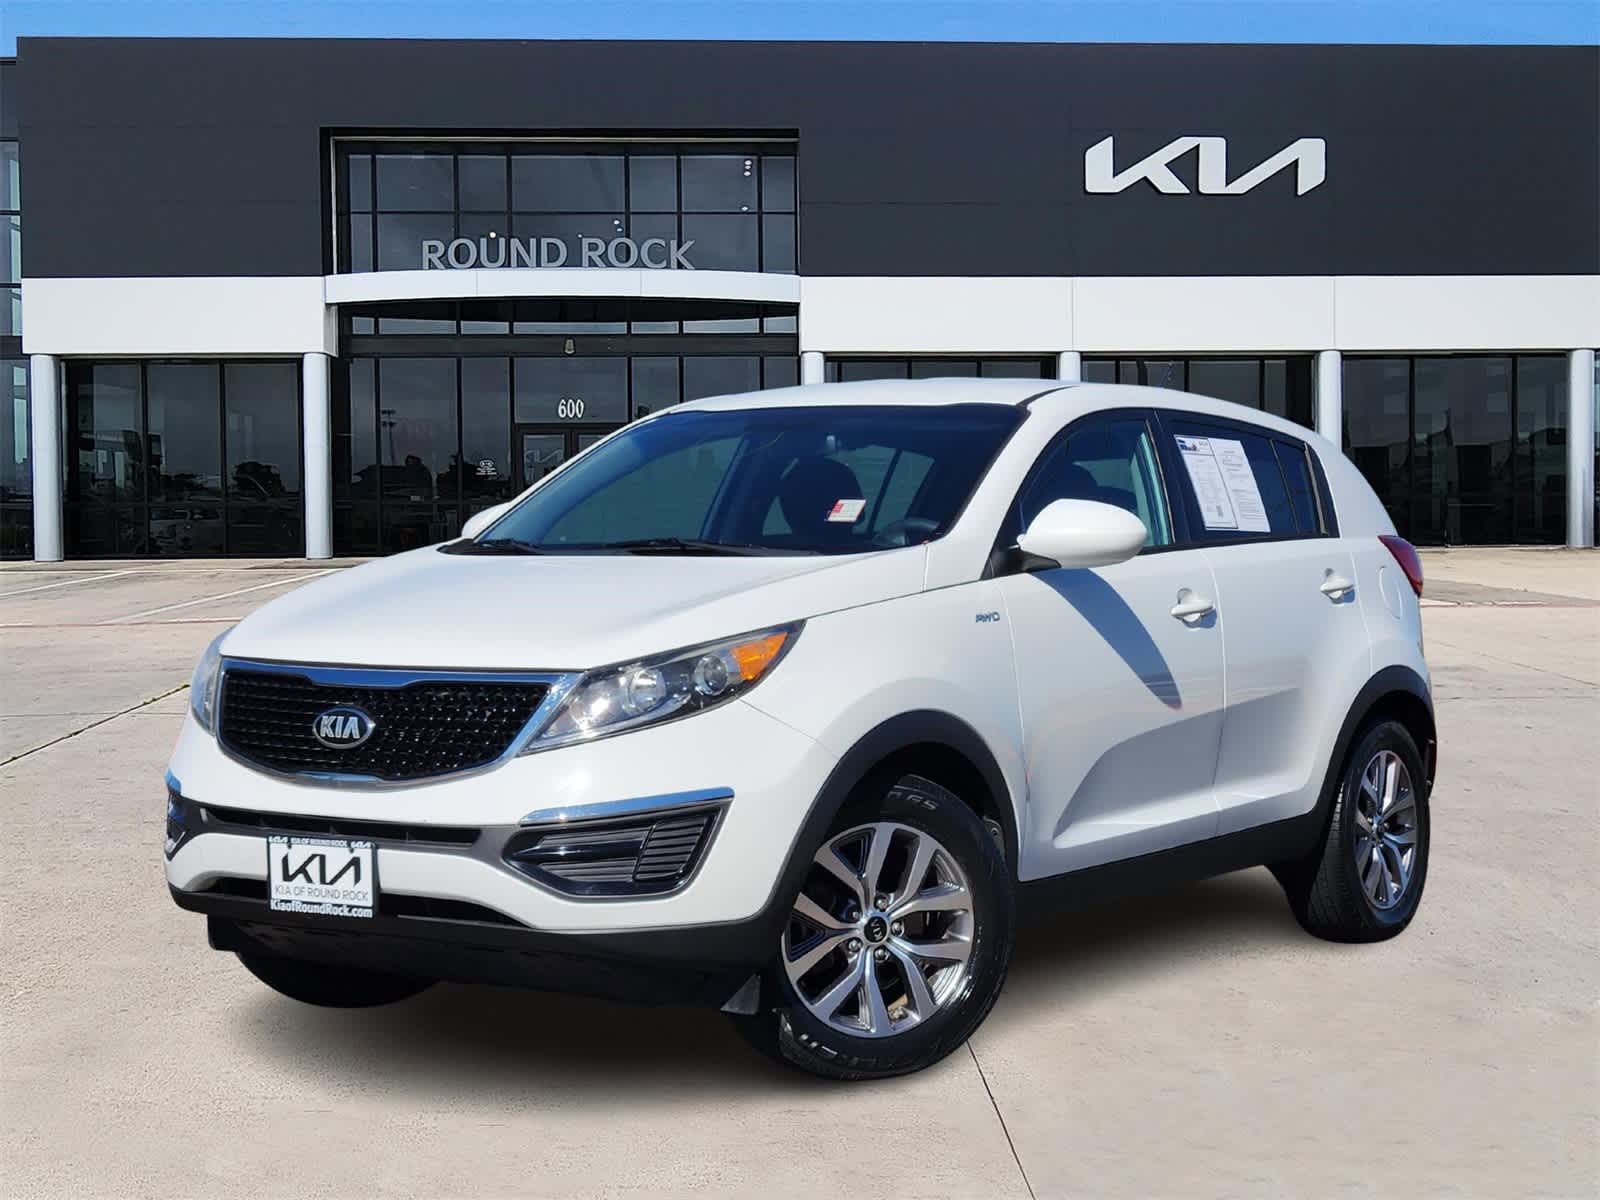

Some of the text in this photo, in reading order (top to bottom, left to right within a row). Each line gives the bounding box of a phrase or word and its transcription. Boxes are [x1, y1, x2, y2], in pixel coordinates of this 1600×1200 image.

[1085, 135, 1326, 196] KIA
[421, 237, 696, 270] ROUND ROCK
[558, 399, 585, 419] 600
[320, 715, 361, 739] KIA
[281, 852, 361, 888] KIA
[275, 885, 369, 902] KIA OF ROUND ROCK
[270, 900, 373, 919] KiaofRoundRock.com
